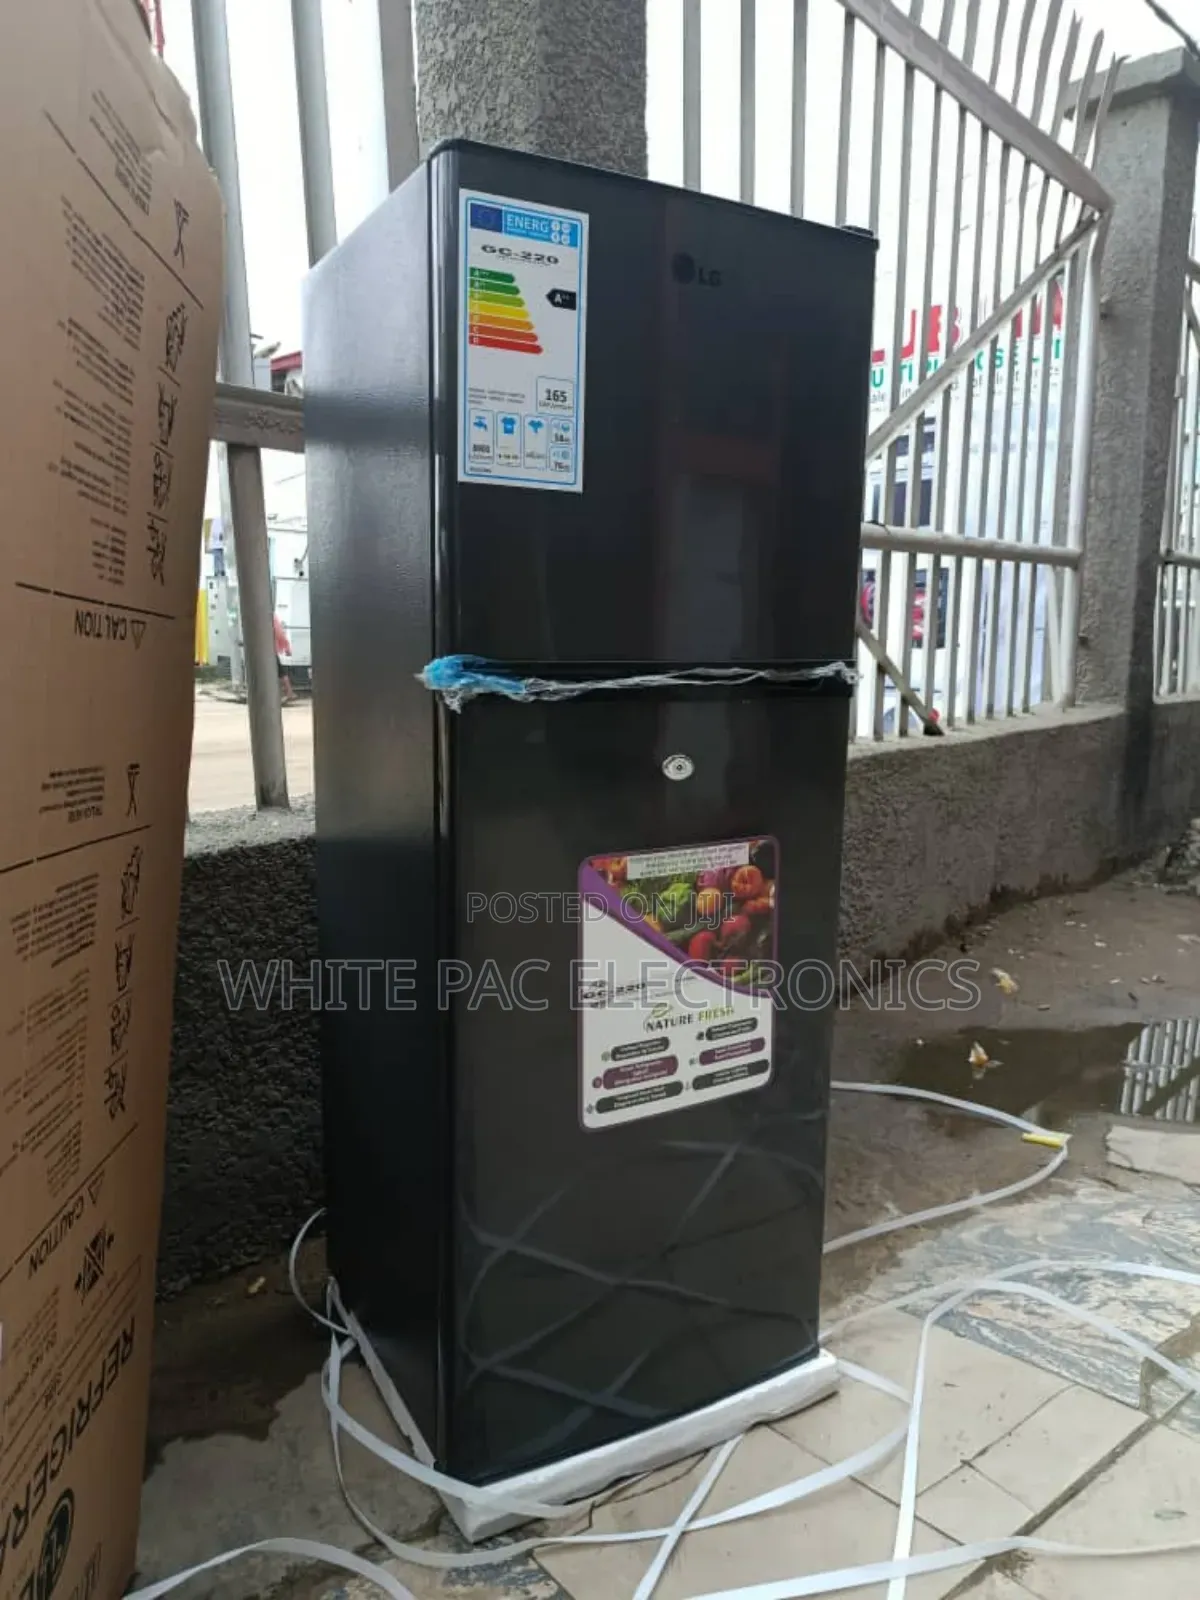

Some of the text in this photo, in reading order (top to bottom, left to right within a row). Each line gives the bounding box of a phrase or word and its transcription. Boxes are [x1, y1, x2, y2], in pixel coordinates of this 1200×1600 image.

[506, 213, 549, 233] ENERG
[481, 244, 559, 264] GC-220
[698, 267, 722, 287] LG
[545, 388, 568, 402] 165
[75, 608, 127, 641] CAUTION
[645, 1014, 693, 1032] NATURE
[28, 1195, 84, 1280] CAUTION
